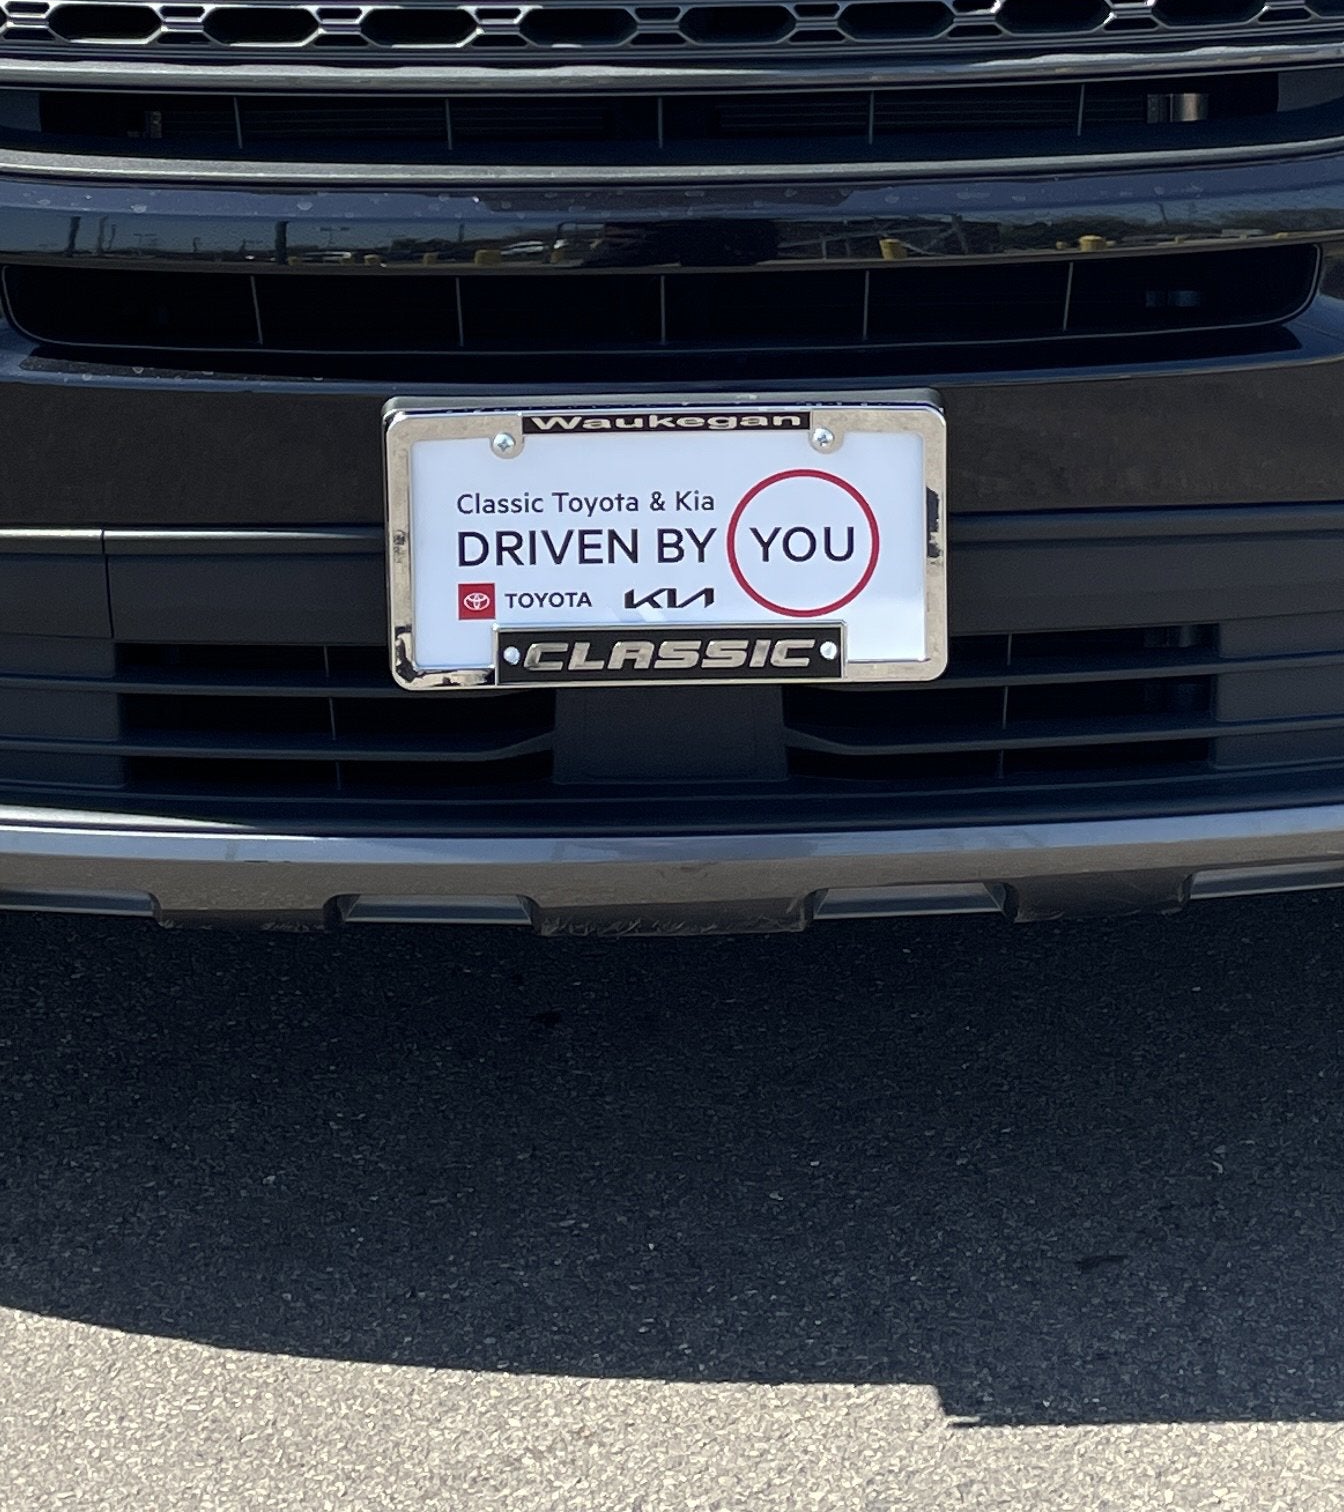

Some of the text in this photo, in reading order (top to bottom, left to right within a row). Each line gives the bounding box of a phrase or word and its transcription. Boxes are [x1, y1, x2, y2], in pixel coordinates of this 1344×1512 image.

[529, 413, 802, 431] Waukegan
[456, 490, 716, 518] Classic Toyota & Kia
[457, 525, 855, 567] DRIVEN BY YOU
[503, 591, 593, 609] TOYOTA
[521, 637, 817, 672] CLASSIC
